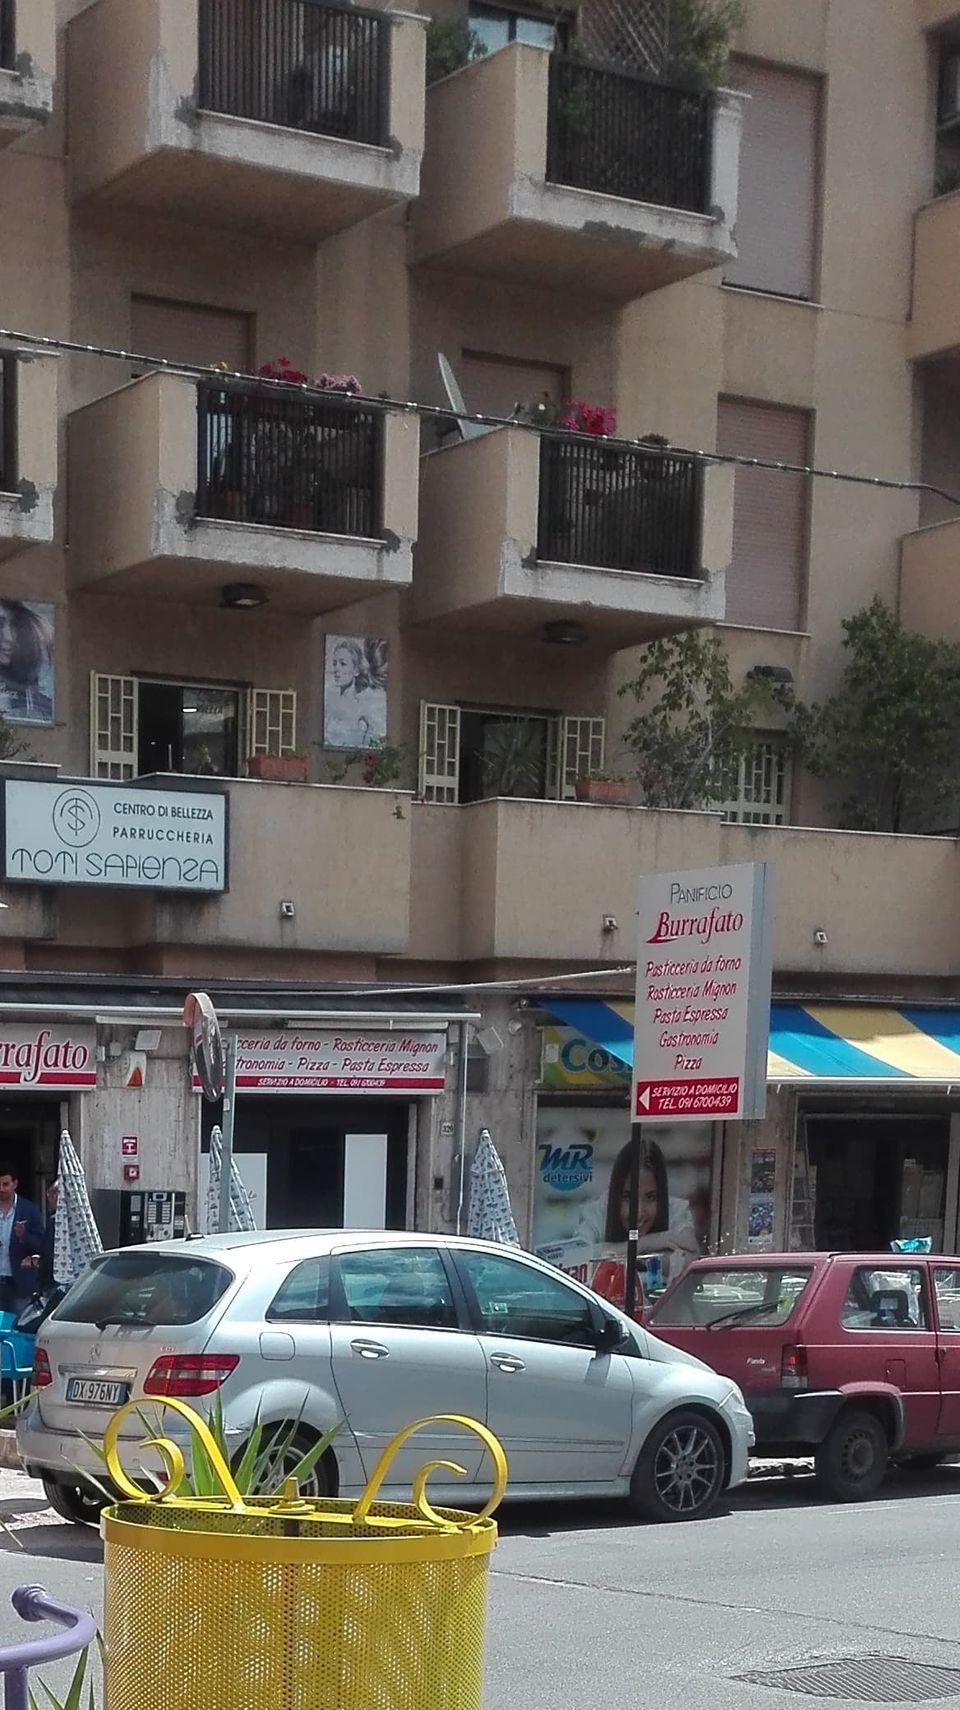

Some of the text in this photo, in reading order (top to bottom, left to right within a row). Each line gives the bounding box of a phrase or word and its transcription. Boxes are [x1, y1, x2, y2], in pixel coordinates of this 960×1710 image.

[113, 802, 214, 821] CENTRO DI BELLEZZA
[112, 826, 214, 845] PARRUCCHERIA
[11, 848, 78, 876] TOTI
[670, 882, 733, 905] PANIFICIO
[646, 906, 744, 945] Burrafato
[645, 955, 742, 978] Pasticceria da forno
[647, 979, 737, 1002] Rosticceria Mignon
[652, 1004, 729, 1025] Pasta Espressa
[272, 1036, 288, 1051] da
[290, 1036, 321, 1051] forno
[332, 1038, 397, 1053] Rosticceria
[398, 1038, 439, 1058] Mignon
[659, 1029, 719, 1048] Gastronomia
[296, 1057, 331, 1071] Pizza
[341, 1057, 376, 1072] Pasta
[377, 1057, 430, 1076] Espressa
[673, 1054, 703, 1071] Pizza
[651, 1082, 738, 1098] SERVIZIO A DOMICILIO
[658, 1097, 677, 1110] TEL.
[543, 1173, 593, 1183] detersivi
[72, 1381, 120, 1402] DX 976NY
